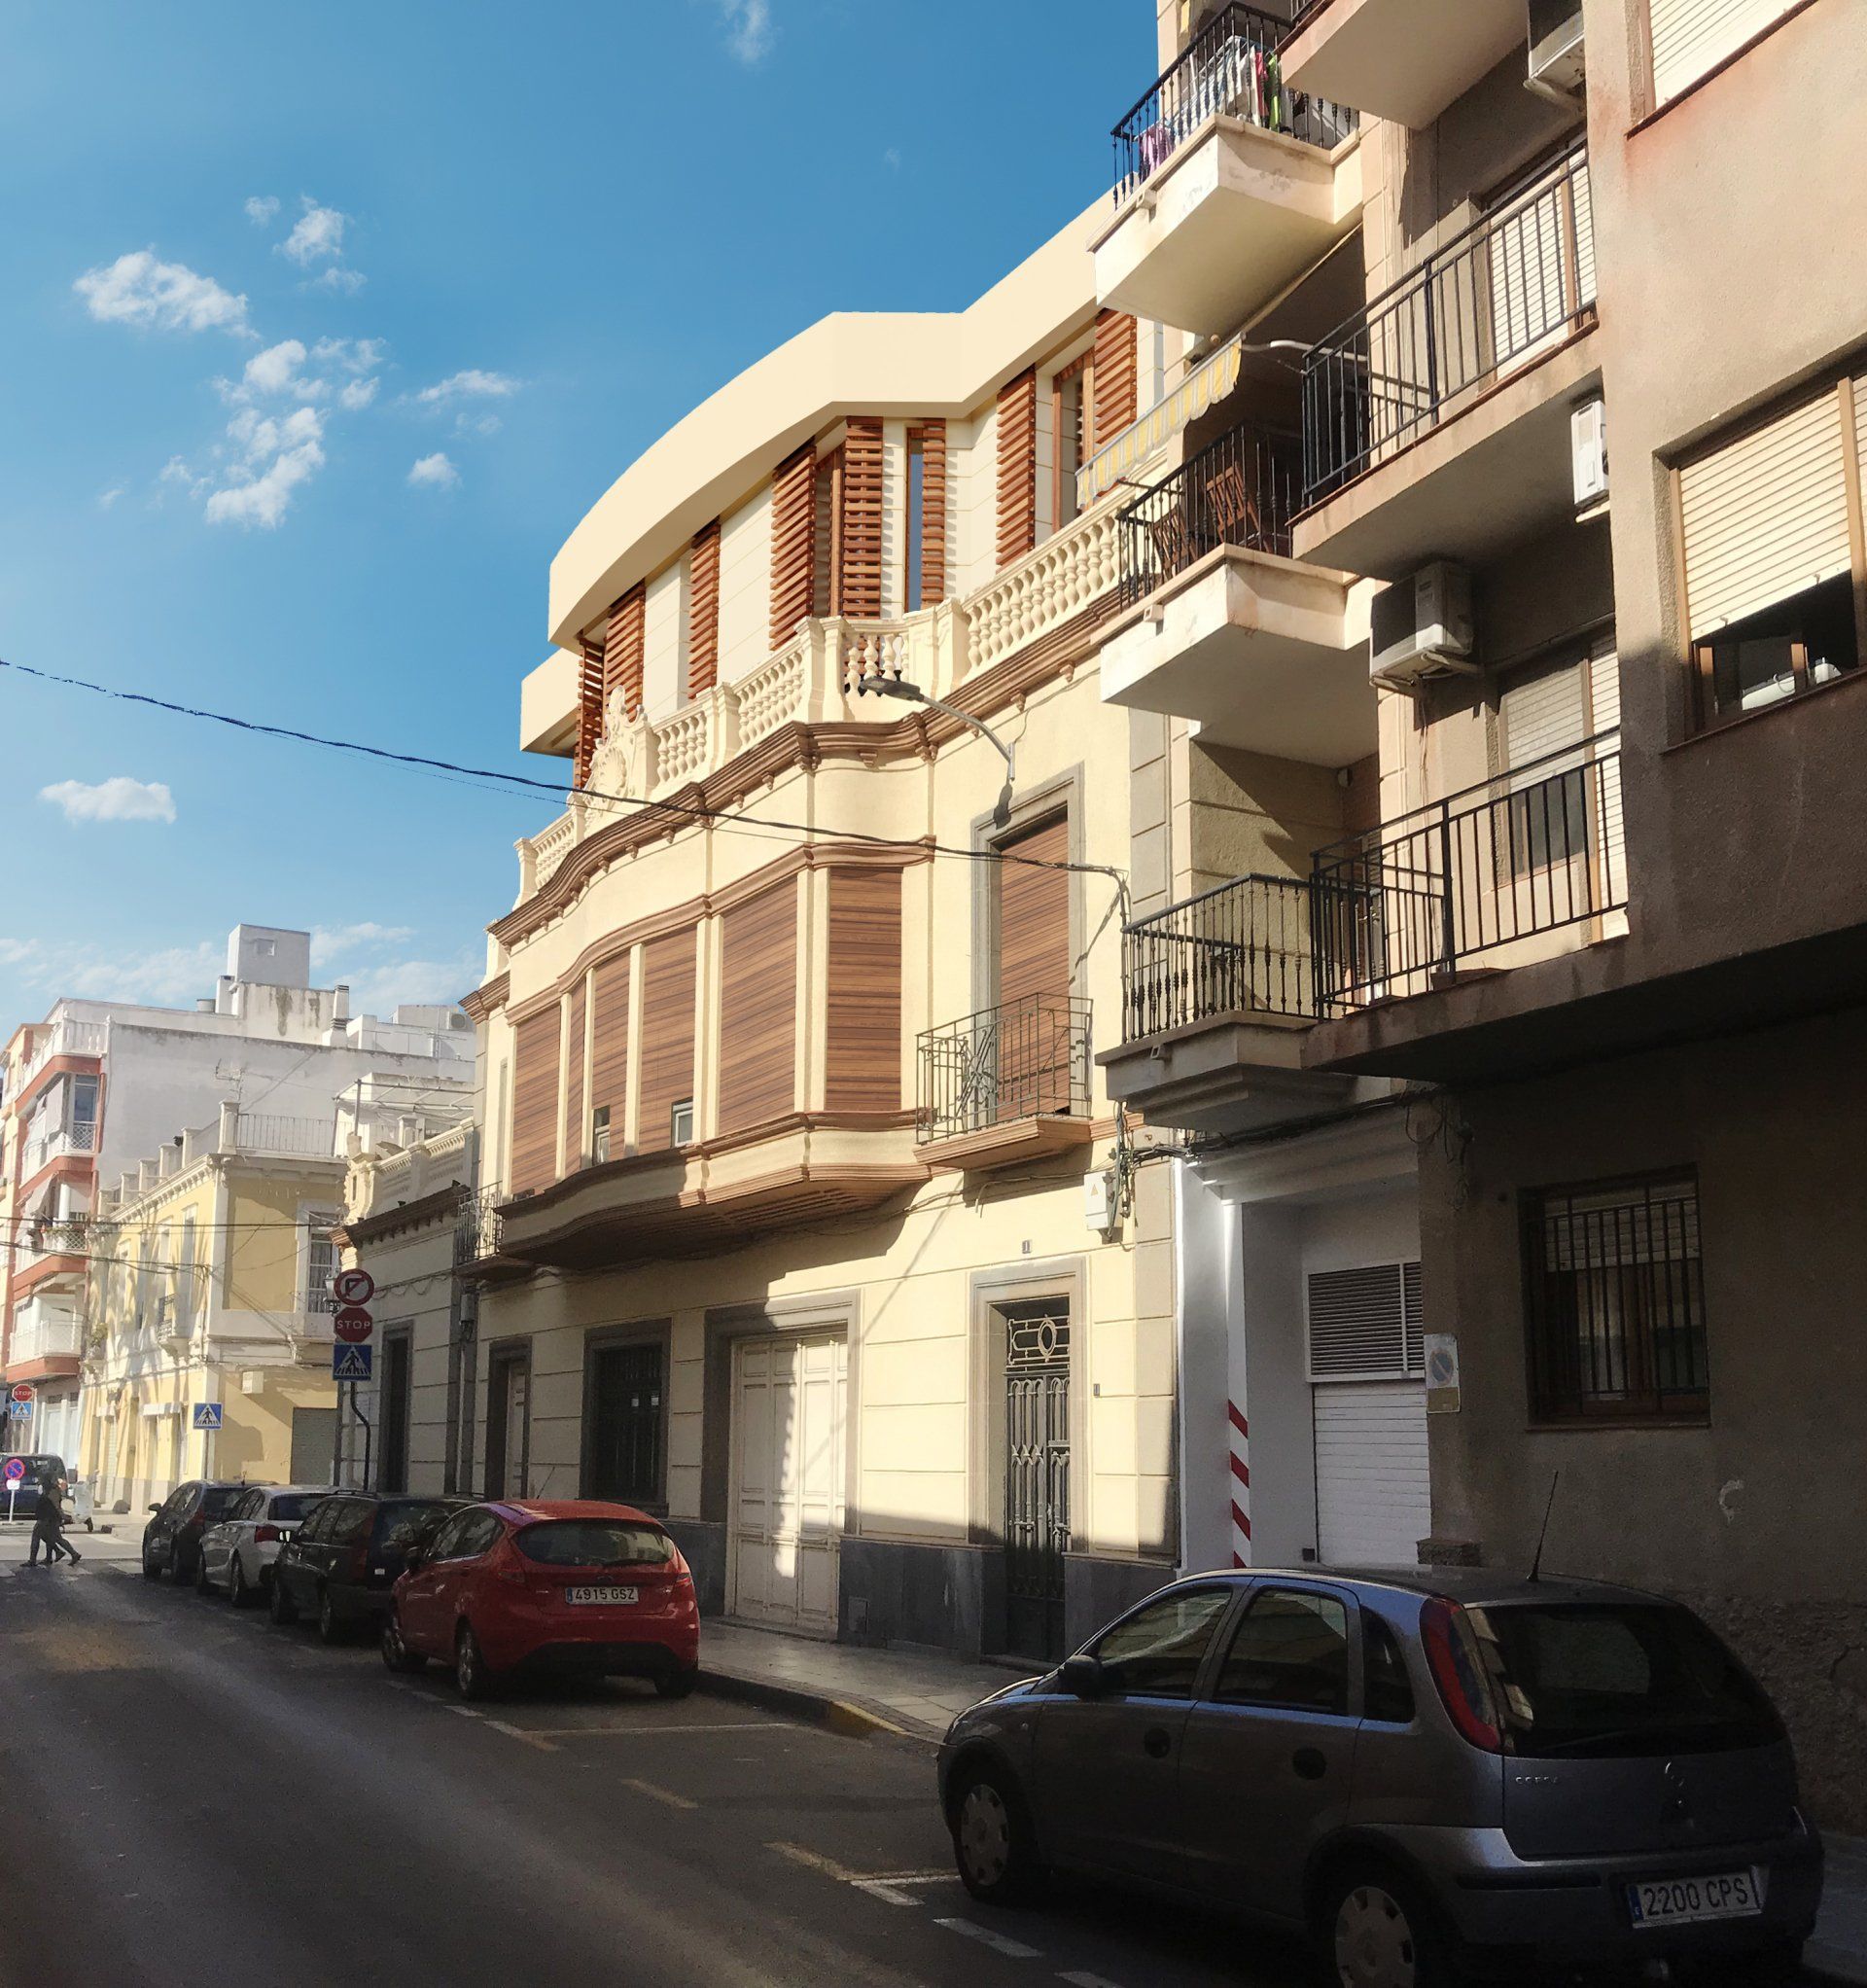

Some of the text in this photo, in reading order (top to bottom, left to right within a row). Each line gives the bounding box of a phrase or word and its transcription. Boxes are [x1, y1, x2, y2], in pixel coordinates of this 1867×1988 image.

[336, 1320, 370, 1330] STOP
[576, 1588, 634, 1600] 4915 GSZ
[1643, 1877, 1748, 1916] 2200 CPS
